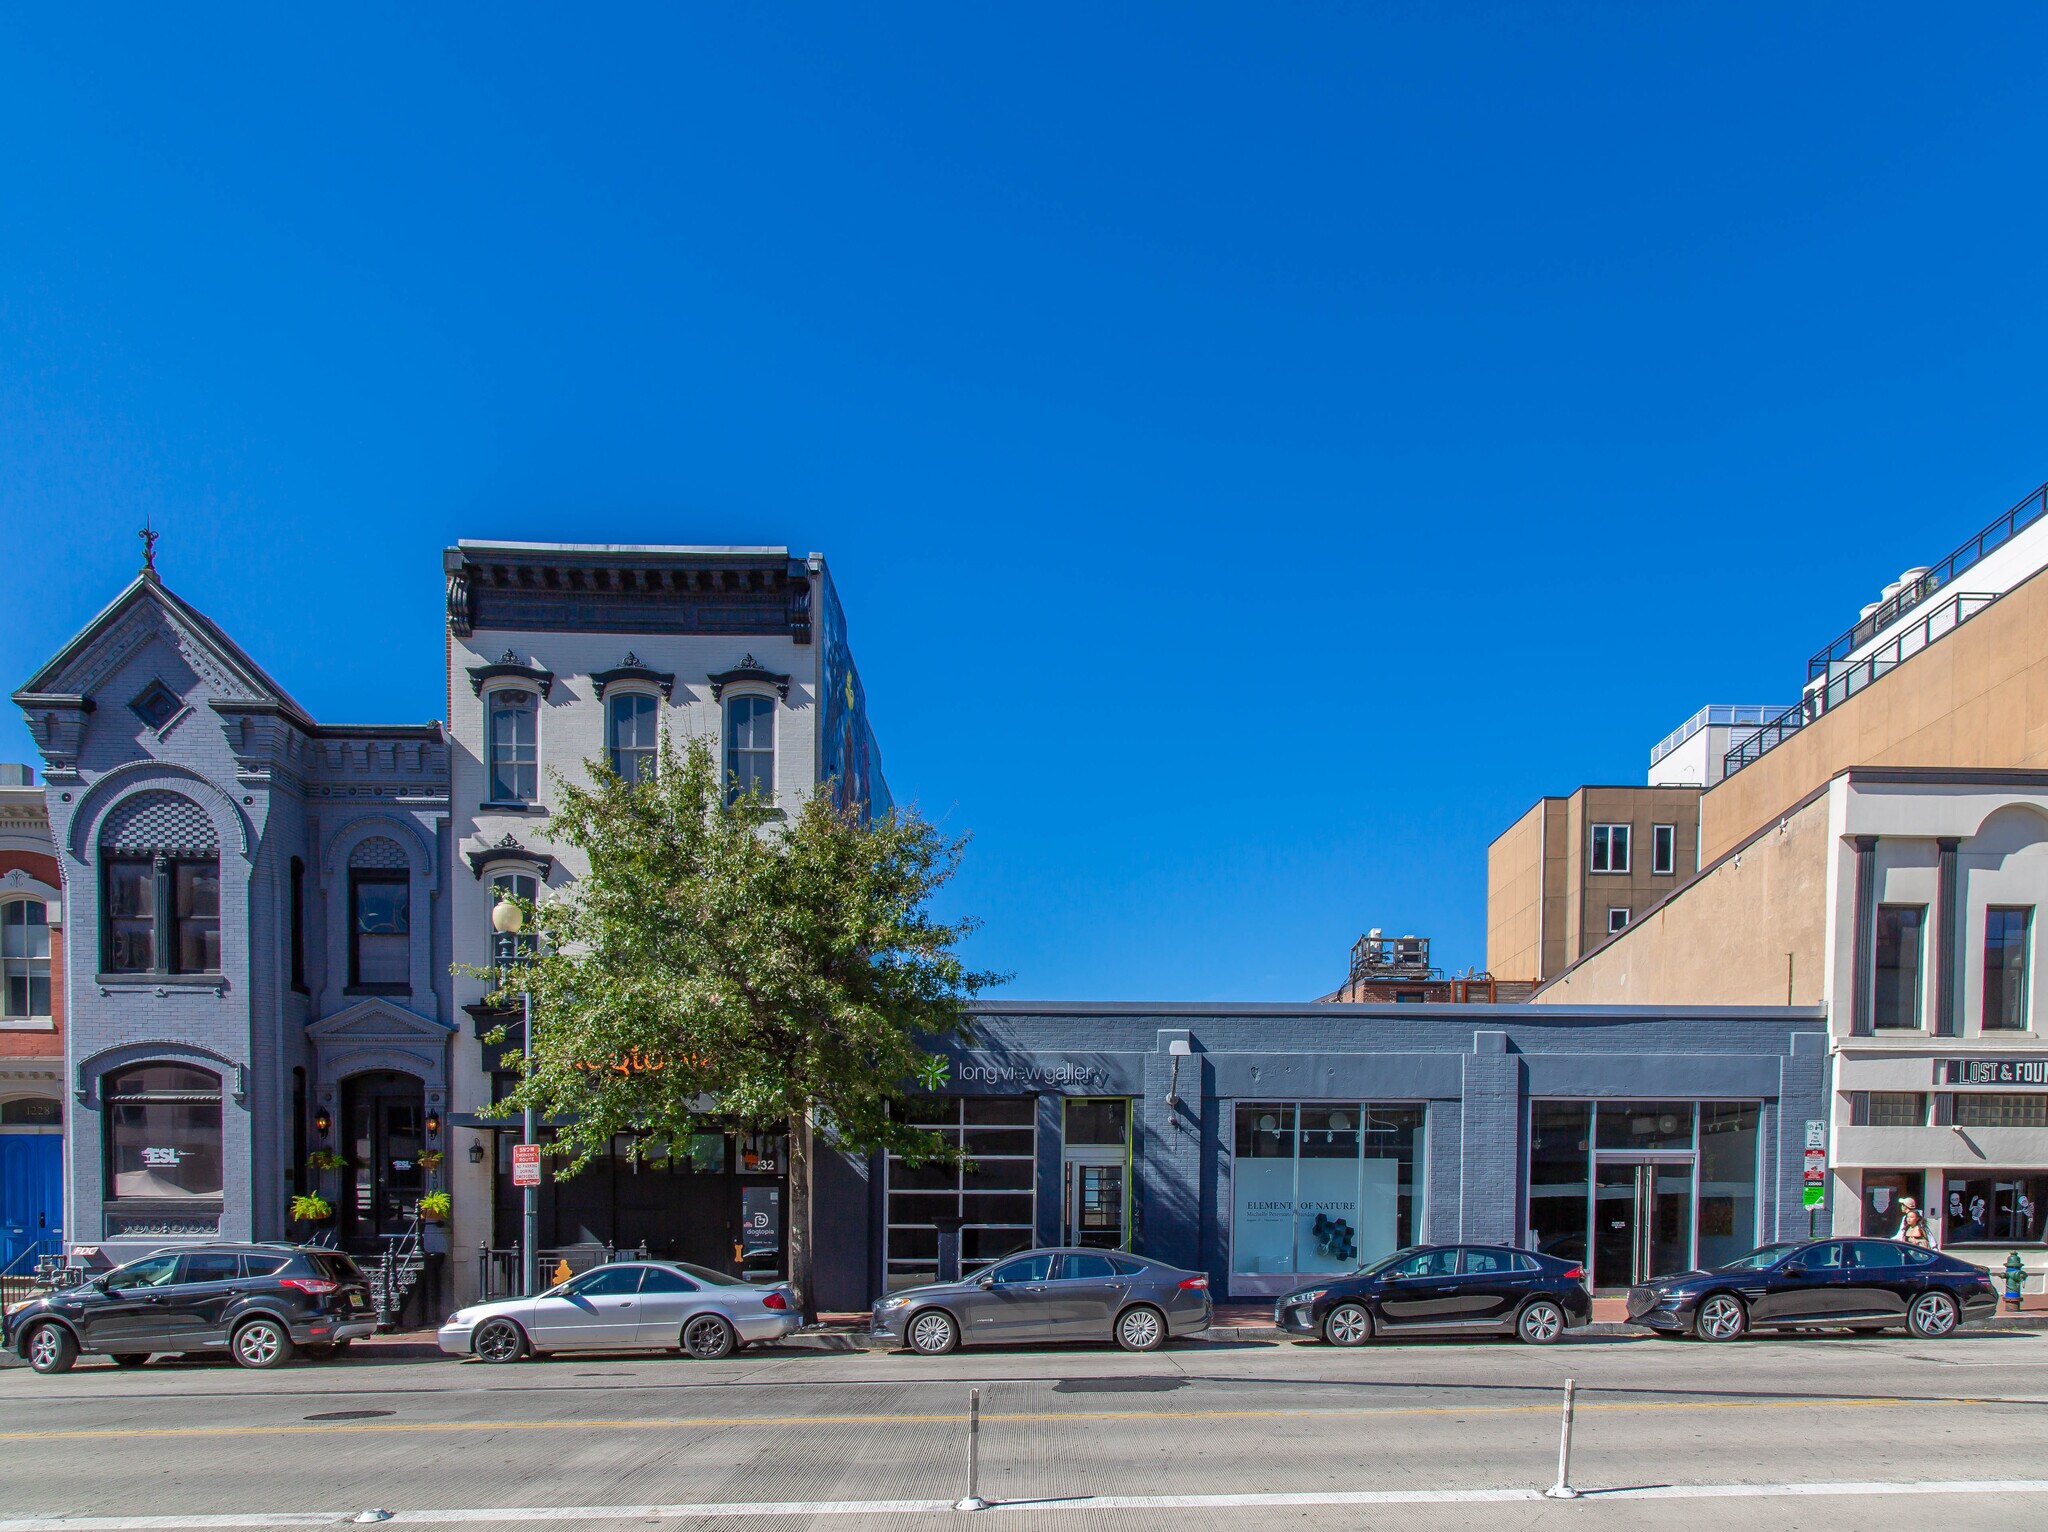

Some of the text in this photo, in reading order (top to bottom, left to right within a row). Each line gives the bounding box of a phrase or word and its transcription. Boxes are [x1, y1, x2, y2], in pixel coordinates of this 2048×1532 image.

[959, 1062, 997, 1085] long
[1960, 1060, 2048, 1084] LOST & FOU
[27, 1106, 50, 1116] 1228
[149, 1148, 180, 1163] ESL
[1300, 1201, 1314, 1210] OF
[1316, 1201, 1356, 1210] NATURE
[746, 1228, 775, 1237] dogtopia
